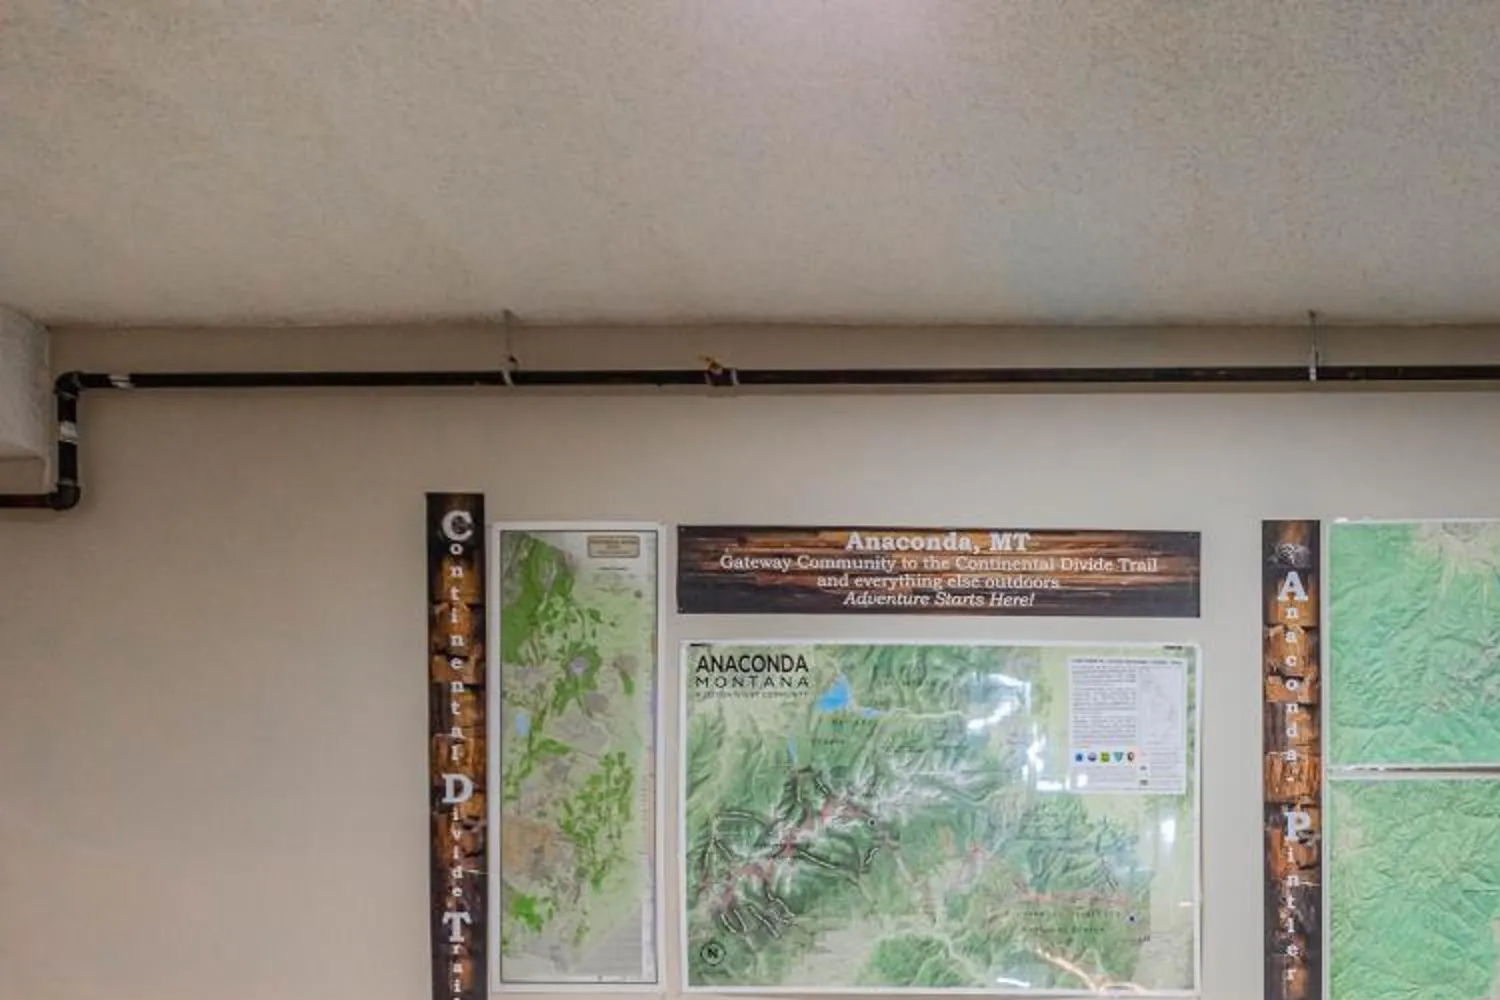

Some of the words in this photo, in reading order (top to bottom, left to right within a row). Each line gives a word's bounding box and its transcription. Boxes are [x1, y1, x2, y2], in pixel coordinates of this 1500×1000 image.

[846, 532, 980, 554] Anaconda,
[990, 532, 1030, 550] MT
[719, 555, 791, 572] Gateway
[797, 555, 896, 573] Community
[902, 556, 919, 569] to
[923, 555, 949, 570] the
[955, 556, 1055, 571] Continental
[1061, 557, 1113, 571] Divide
[1118, 558, 1158, 572] Trail
[817, 574, 849, 588] and
[855, 574, 942, 590] everything
[948, 574, 981, 588] else
[984, 575, 1060, 589] outdoors
[843, 591, 930, 606] Adventure
[934, 591, 984, 606] Starts
[989, 592, 1036, 606] Here!
[441, 509, 473, 762] Continental
[695, 655, 809, 673] ANACONDA
[695, 676, 809, 688] MONTANA
[441, 773, 473, 897] Divide
